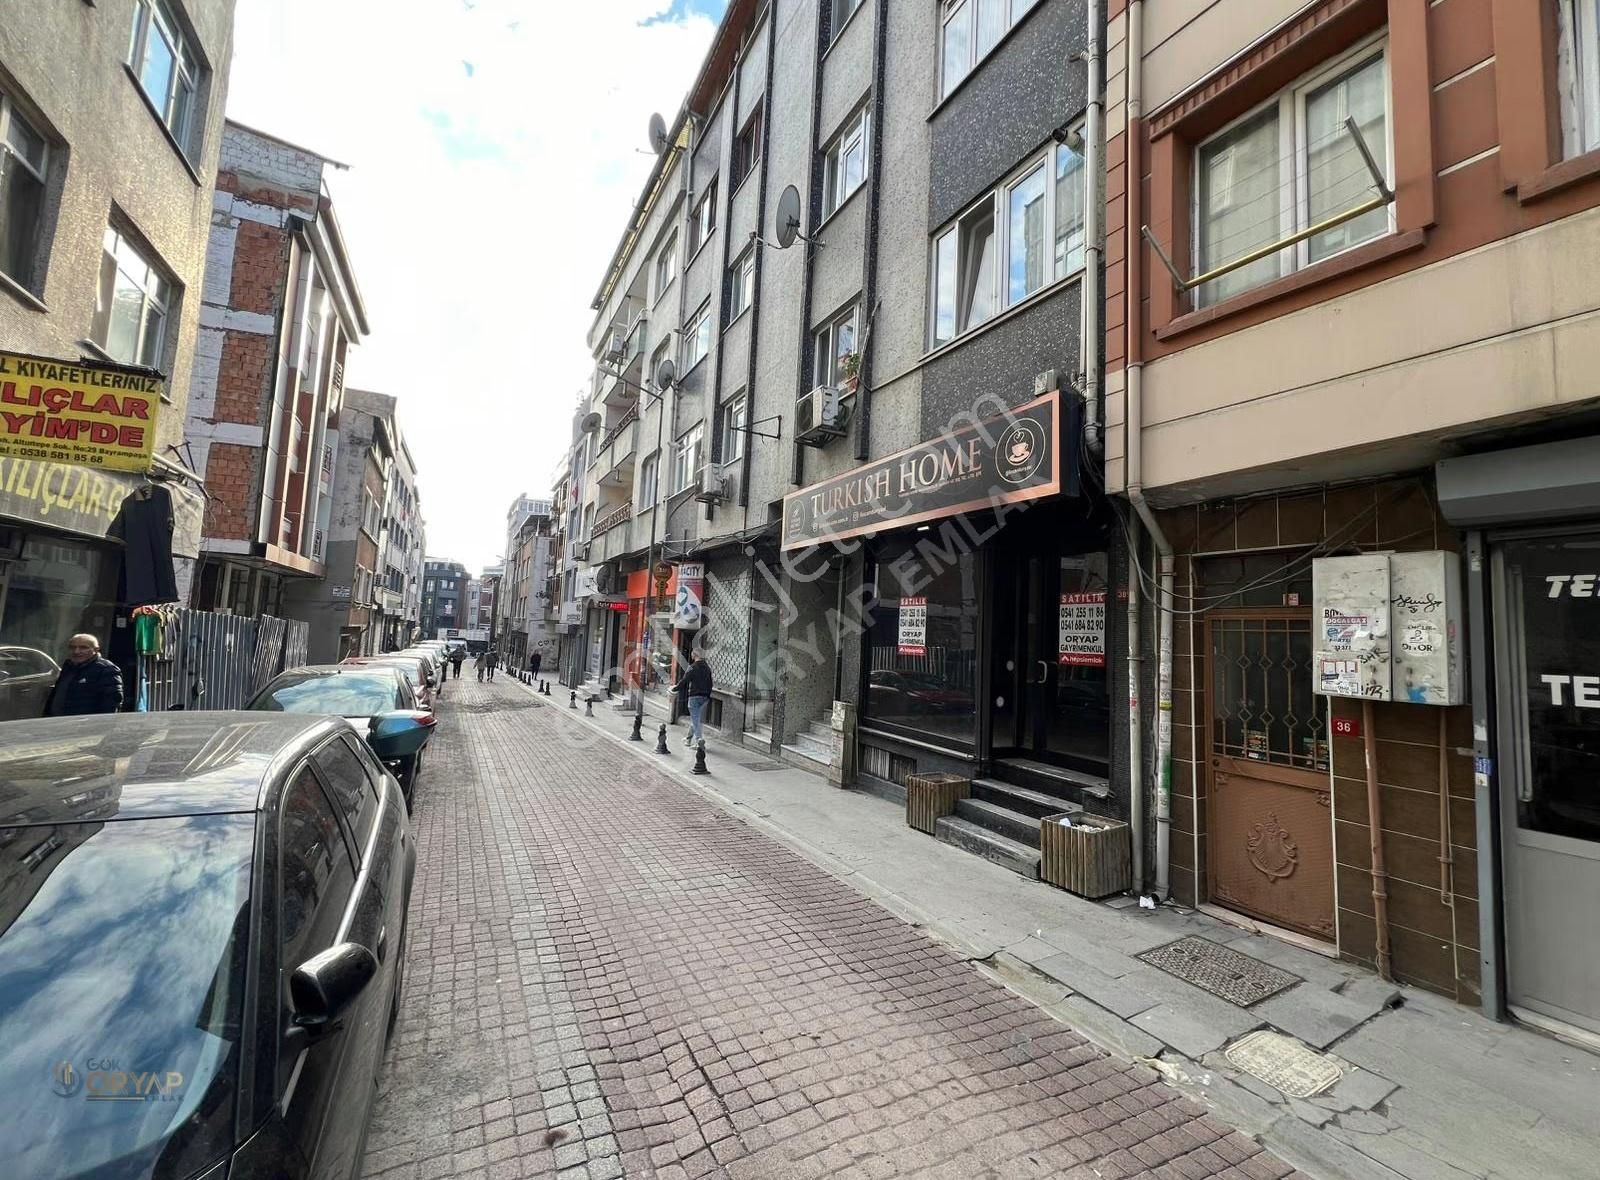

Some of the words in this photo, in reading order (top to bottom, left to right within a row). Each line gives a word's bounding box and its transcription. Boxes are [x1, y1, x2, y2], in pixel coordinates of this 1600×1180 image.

[0, 381, 149, 420] LIÇLAR
[20, 447, 47, 458] 0538
[50, 451, 69, 460] 581
[811, 468, 891, 519] TURKISH
[899, 437, 983, 493] HOME
[1546, 574, 1600, 598] TE
[1089, 607, 1094, 618] 11
[1065, 635, 1099, 643] ORYAP
